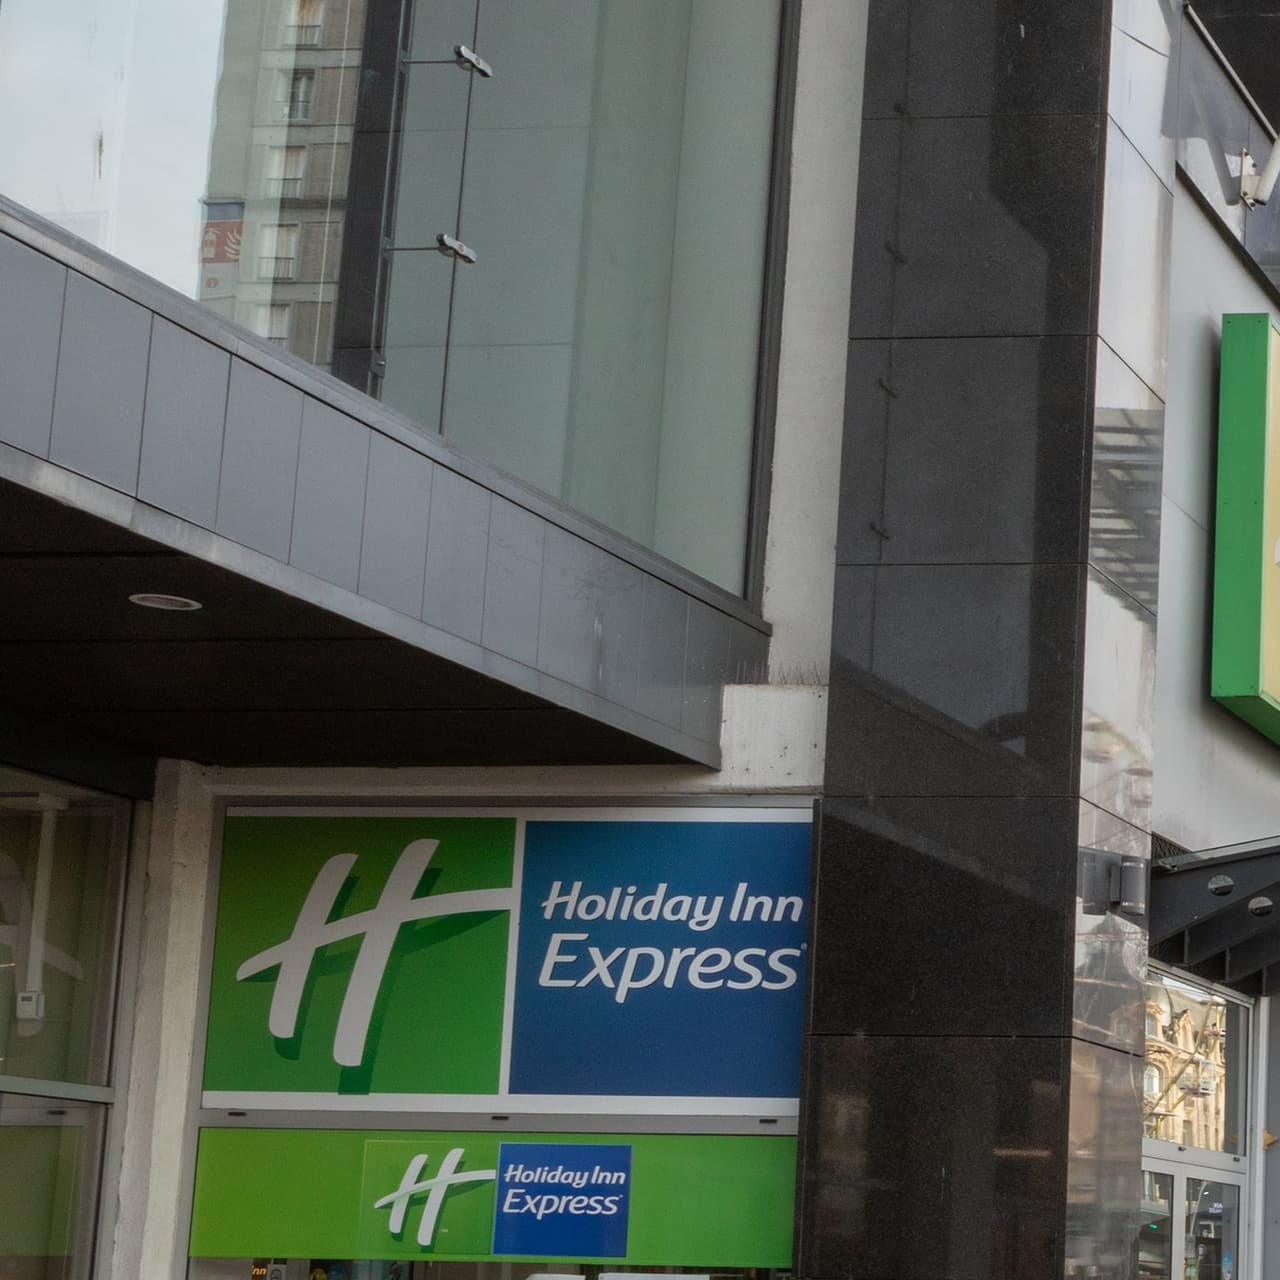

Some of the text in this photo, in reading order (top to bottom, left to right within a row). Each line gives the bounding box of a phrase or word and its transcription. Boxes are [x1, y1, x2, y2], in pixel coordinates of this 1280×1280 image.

[541, 880, 804, 932] Holiday Inn
[538, 933, 802, 1004] Express
[504, 1164, 626, 1189] Holiday Inn
[502, 1188, 620, 1220] Express
